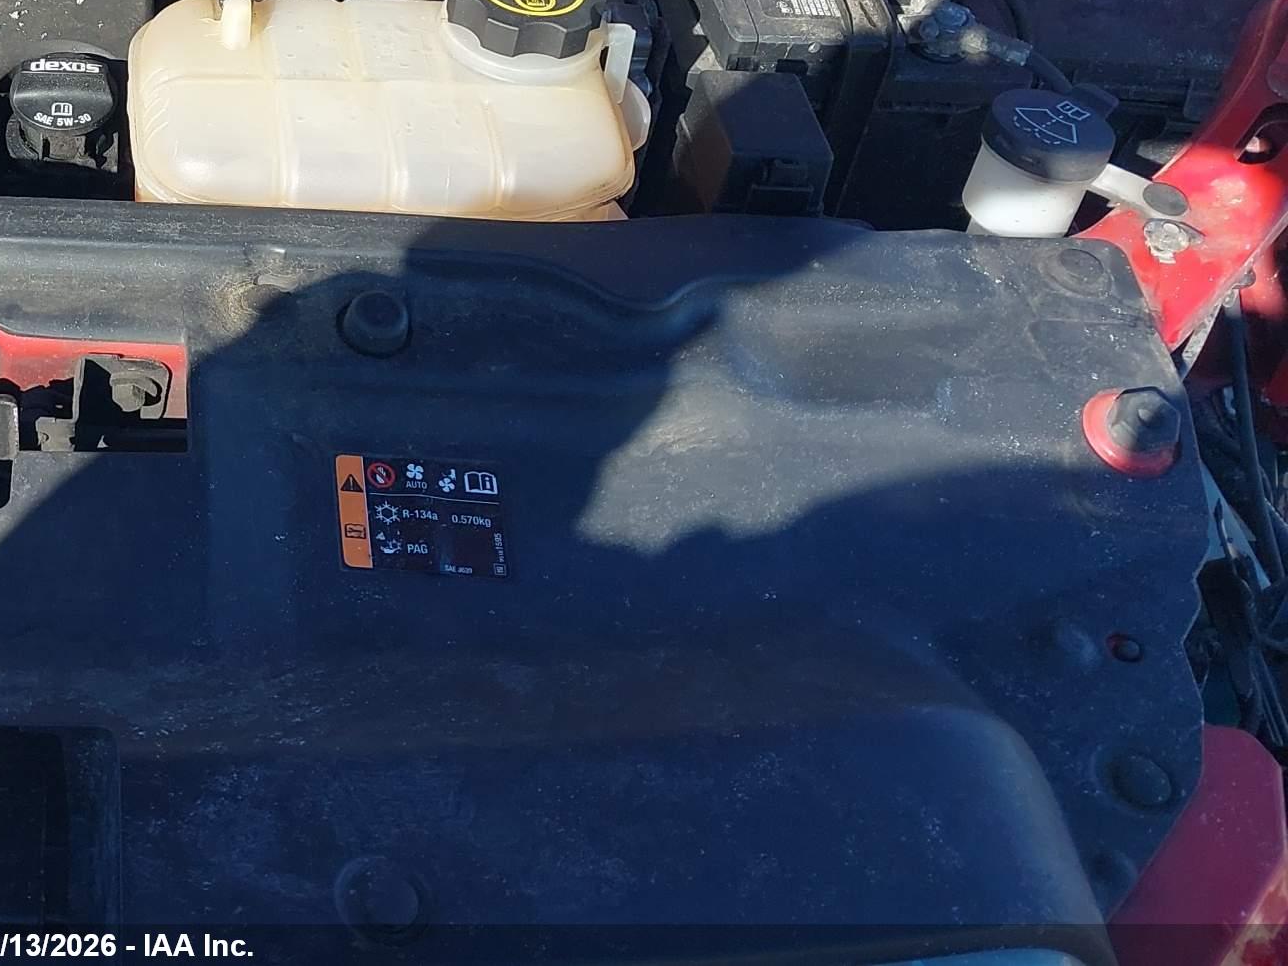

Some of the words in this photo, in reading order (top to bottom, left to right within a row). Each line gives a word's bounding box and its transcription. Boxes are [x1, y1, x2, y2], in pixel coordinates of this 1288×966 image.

[30, 59, 103, 73] dexos
[34, 112, 54, 125] SAE
[57, 113, 92, 126] 5W-30
[405, 481, 427, 490] AUTO
[402, 509, 439, 521] R-134a
[451, 514, 492, 528] 0.570kg
[407, 544, 429, 554] PAG
